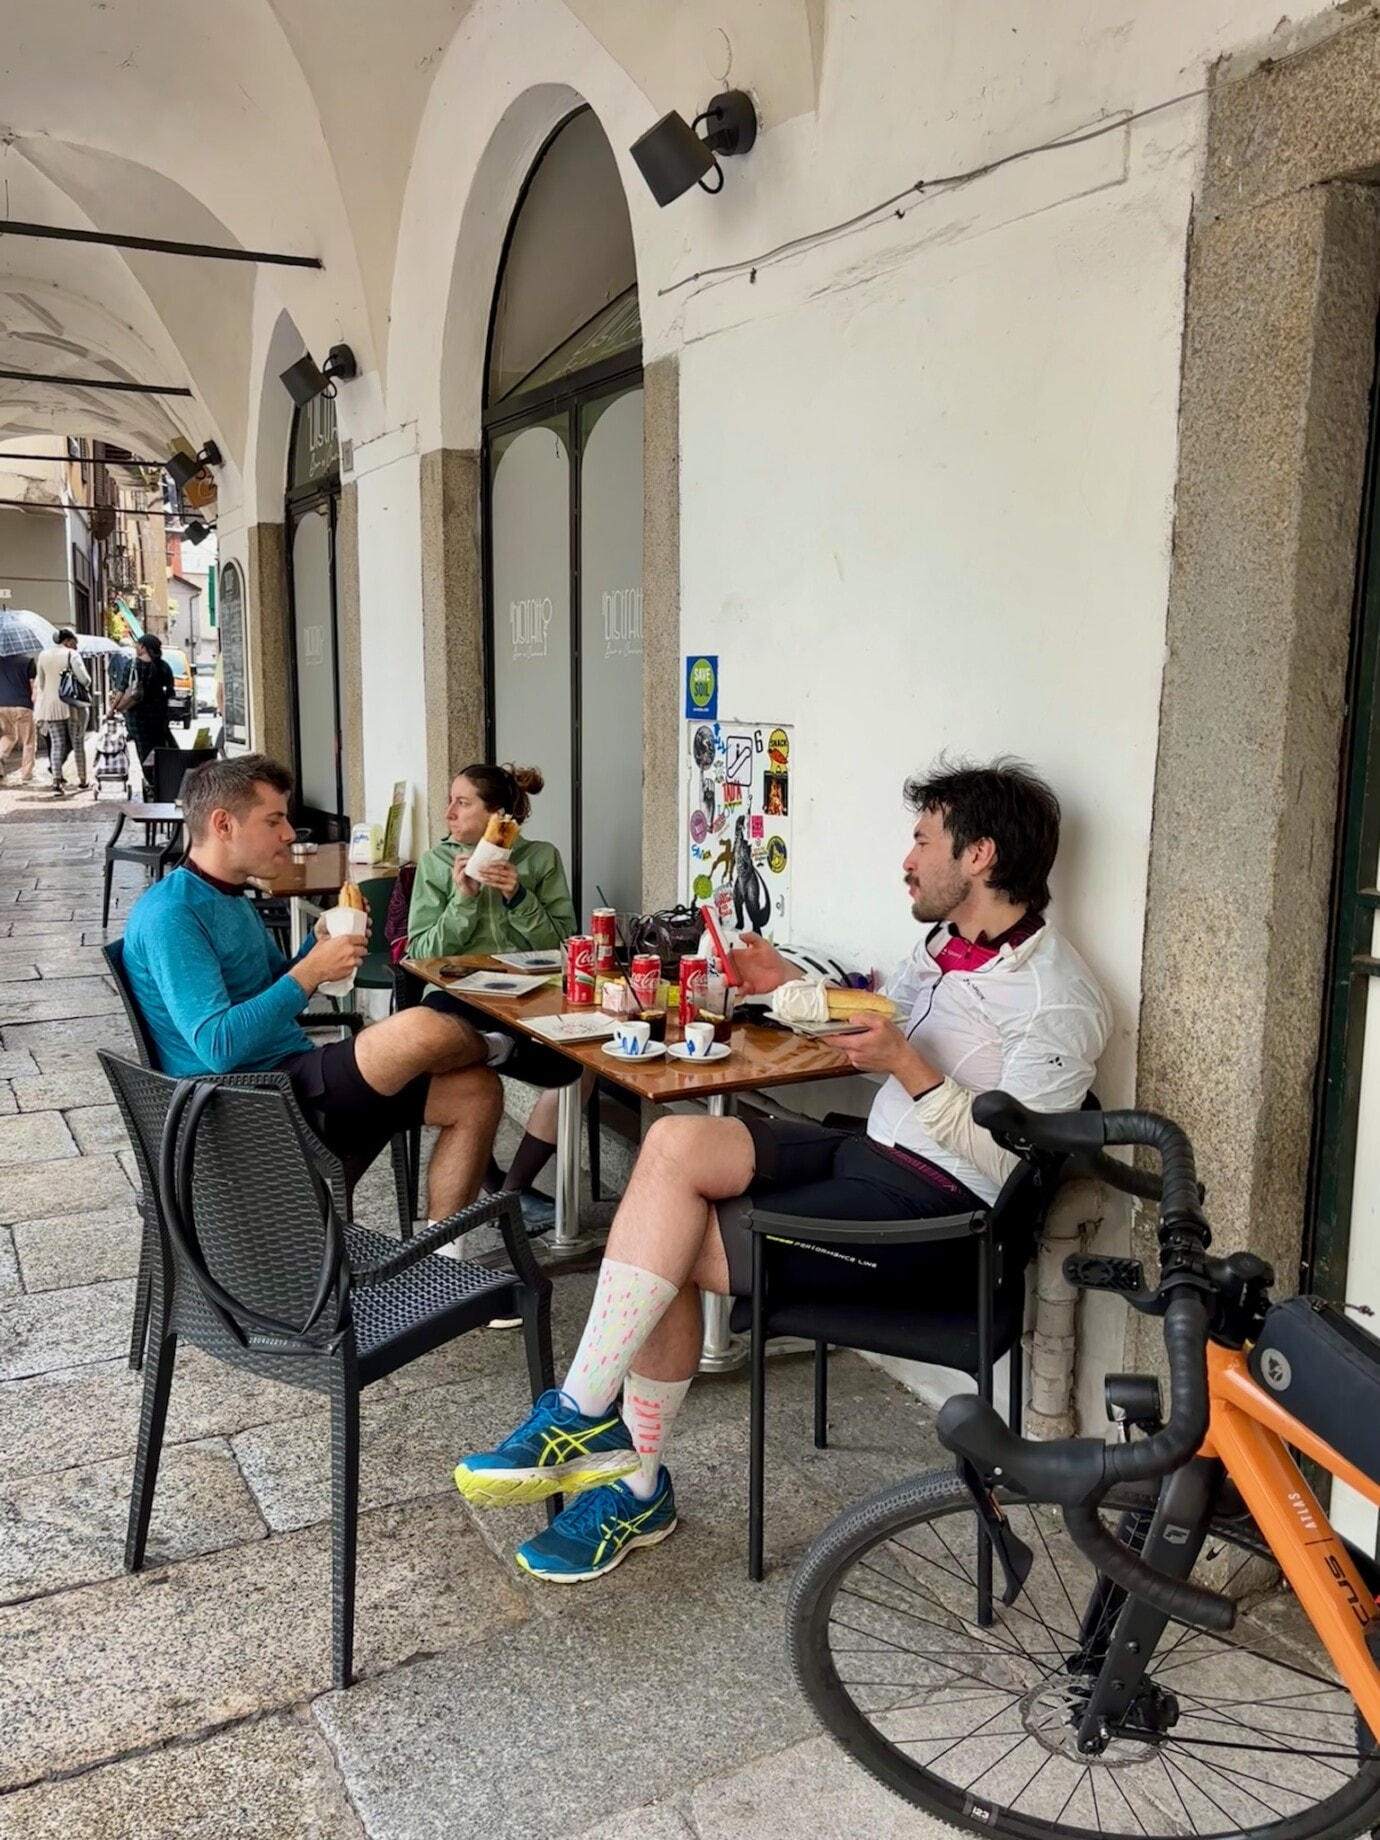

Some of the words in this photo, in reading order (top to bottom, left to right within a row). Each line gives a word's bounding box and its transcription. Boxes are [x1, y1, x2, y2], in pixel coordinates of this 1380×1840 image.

[694, 668, 710, 681] SAVE
[694, 682, 709, 696] SOIL
[794, 1241, 856, 1262] PERFORMANCE
[857, 1259, 878, 1268] LINE
[633, 1396, 661, 1454] FALKE
[1288, 1492, 1317, 1529] ATLAS
[1324, 1554, 1370, 1627] CUS
